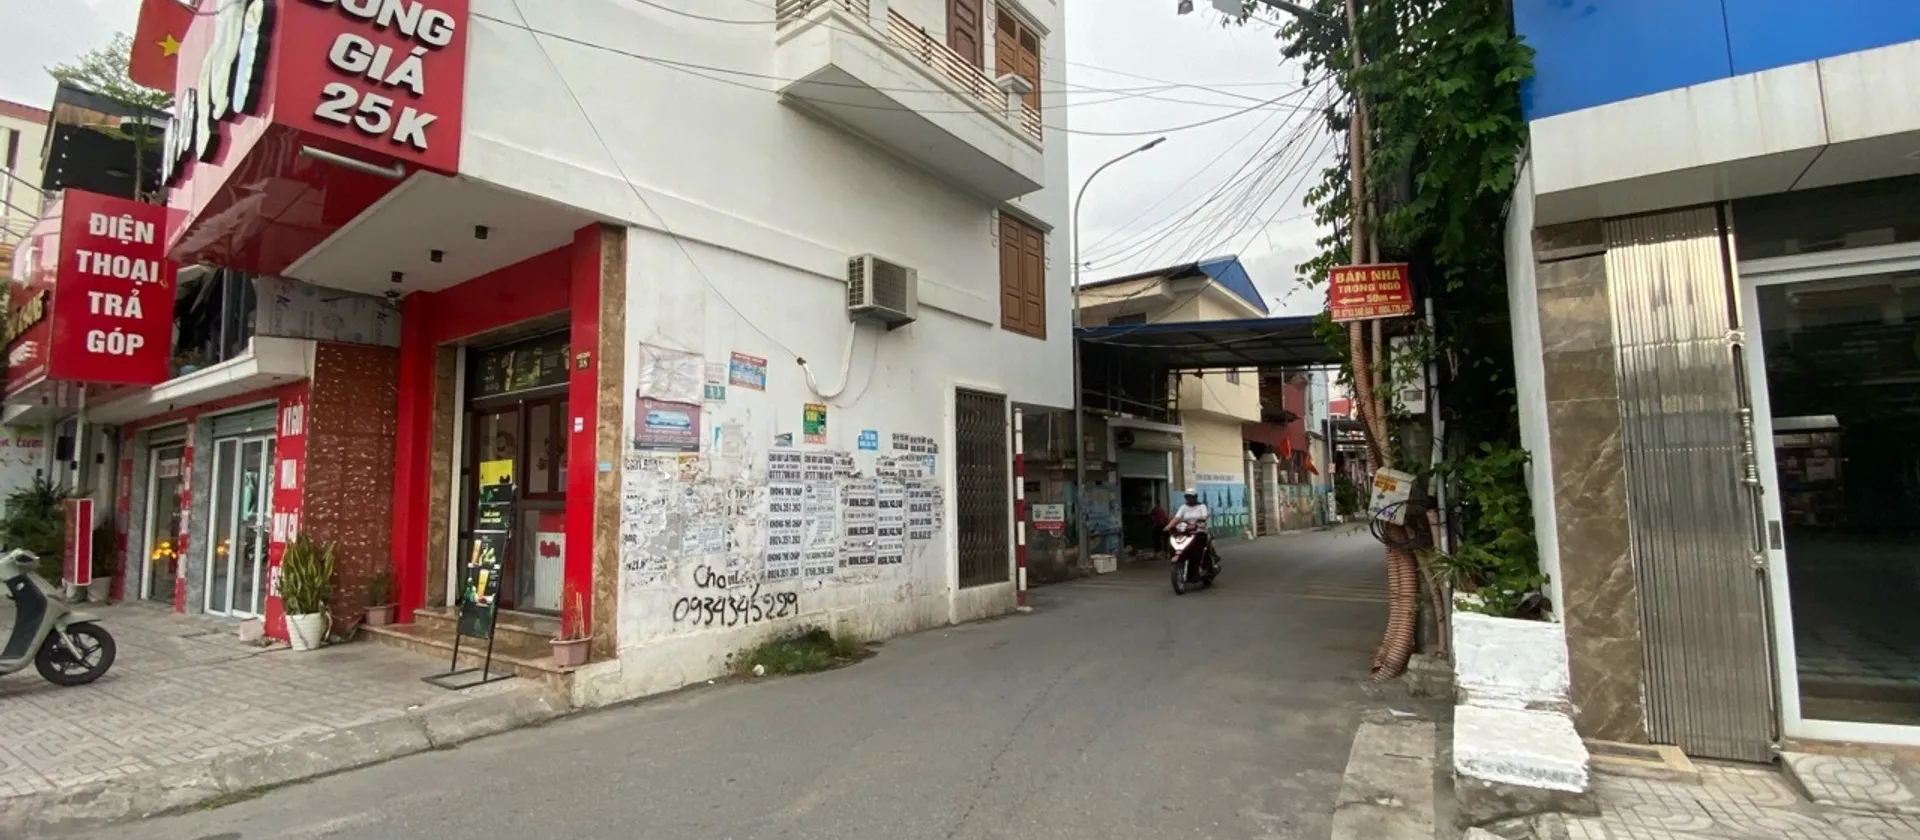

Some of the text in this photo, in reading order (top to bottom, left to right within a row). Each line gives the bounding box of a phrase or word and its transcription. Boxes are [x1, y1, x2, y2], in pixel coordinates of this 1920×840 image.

[312, 0, 456, 47] NG
[329, 33, 429, 95] GIÁ
[89, 212, 154, 245] ĐIỆN
[76, 249, 159, 285] THOẠI
[88, 288, 143, 320] TRẢ
[1338, 283, 1376, 294] TRONG
[86, 327, 145, 356] GÓP
[693, 564, 727, 588] Cho
